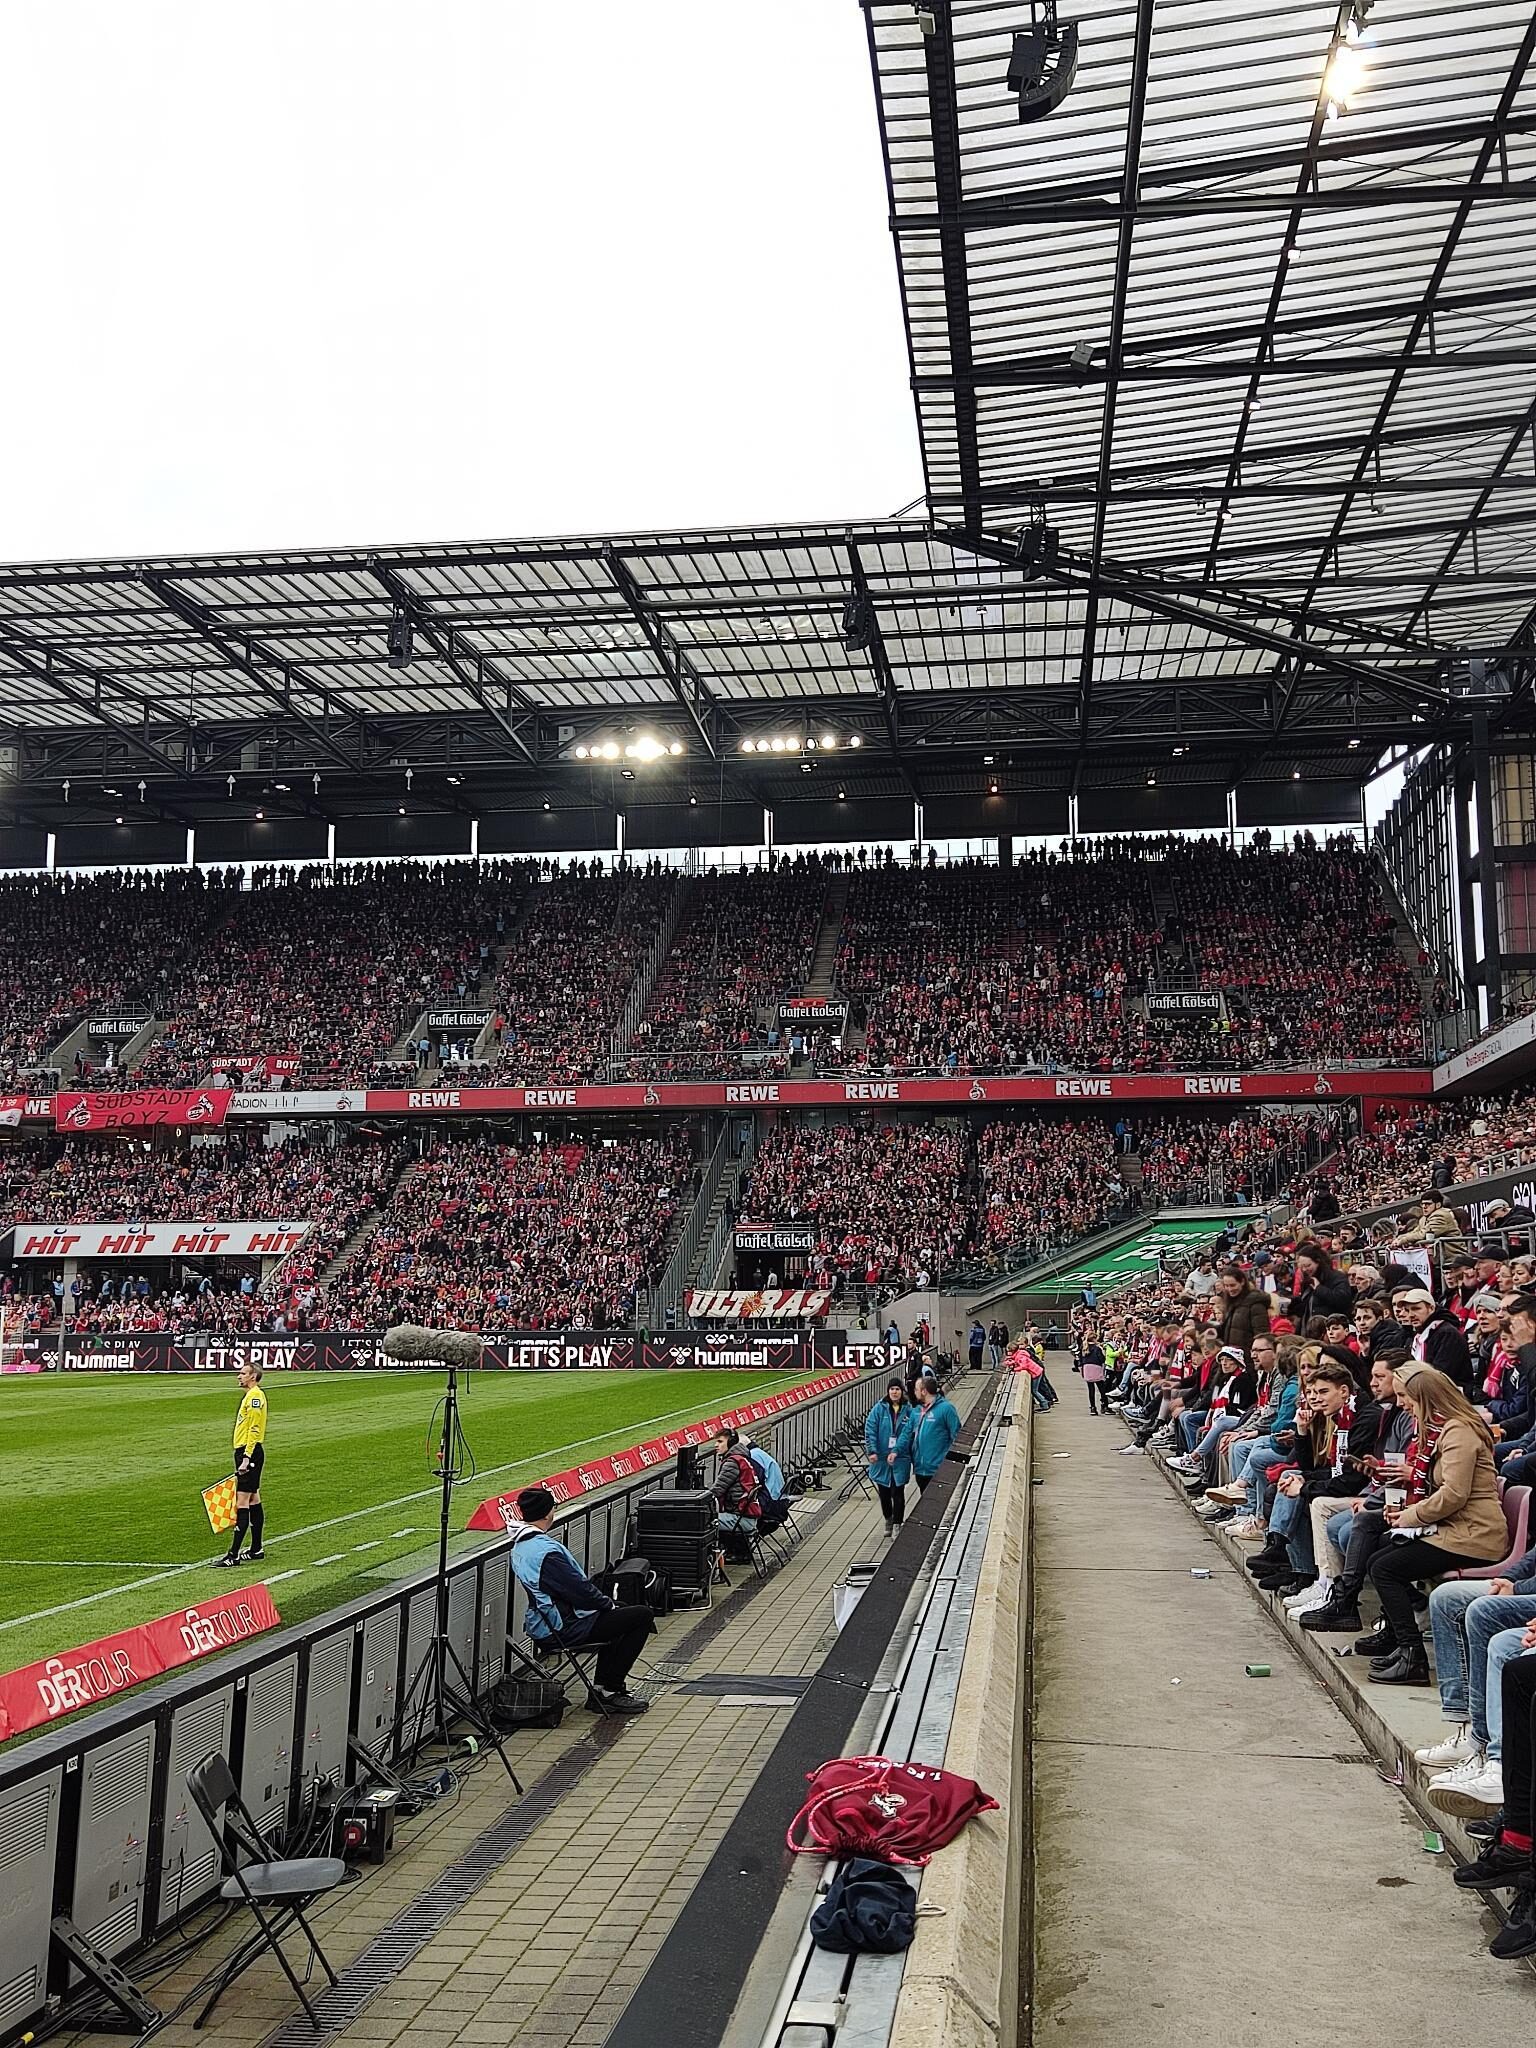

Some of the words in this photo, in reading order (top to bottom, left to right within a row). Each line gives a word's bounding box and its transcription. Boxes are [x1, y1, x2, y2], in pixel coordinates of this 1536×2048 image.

[1148, 995, 1181, 1009] Gaffel
[1182, 994, 1219, 1009] Kölsch
[89, 1021, 118, 1034] Gaffel
[429, 1013, 458, 1026] Gaffel
[726, 1085, 780, 1102] REWE
[845, 1083, 900, 1099] REWE
[1055, 1079, 1112, 1096] REWE
[1184, 1078, 1242, 1094] REWE
[408, 1091, 461, 1108] REWE
[524, 1090, 577, 1106] REWE
[105, 1110, 169, 1129] BOYZ
[23, 1236, 81, 1255] HIT
[99, 1235, 155, 1254] HIT
[172, 1234, 230, 1253] HIT
[247, 1233, 302, 1252] HIT
[735, 1233, 771, 1249] Gaffel
[773, 1232, 815, 1249] Kölsch
[687, 1289, 832, 1318] ULTRAS
[64, 1350, 135, 1369] hummel
[194, 1348, 246, 1369] LET'S
[250, 1348, 297, 1369] PLAY
[507, 1347, 561, 1368] LET'S
[565, 1346, 614, 1368] PLAY
[694, 1346, 768, 1366] hummel
[832, 1345, 885, 1368] LET'S
[180, 1602, 260, 1656] DERTOUR
[36, 1648, 139, 1716] DERTOUR
[906, 1766, 927, 1780] FC
